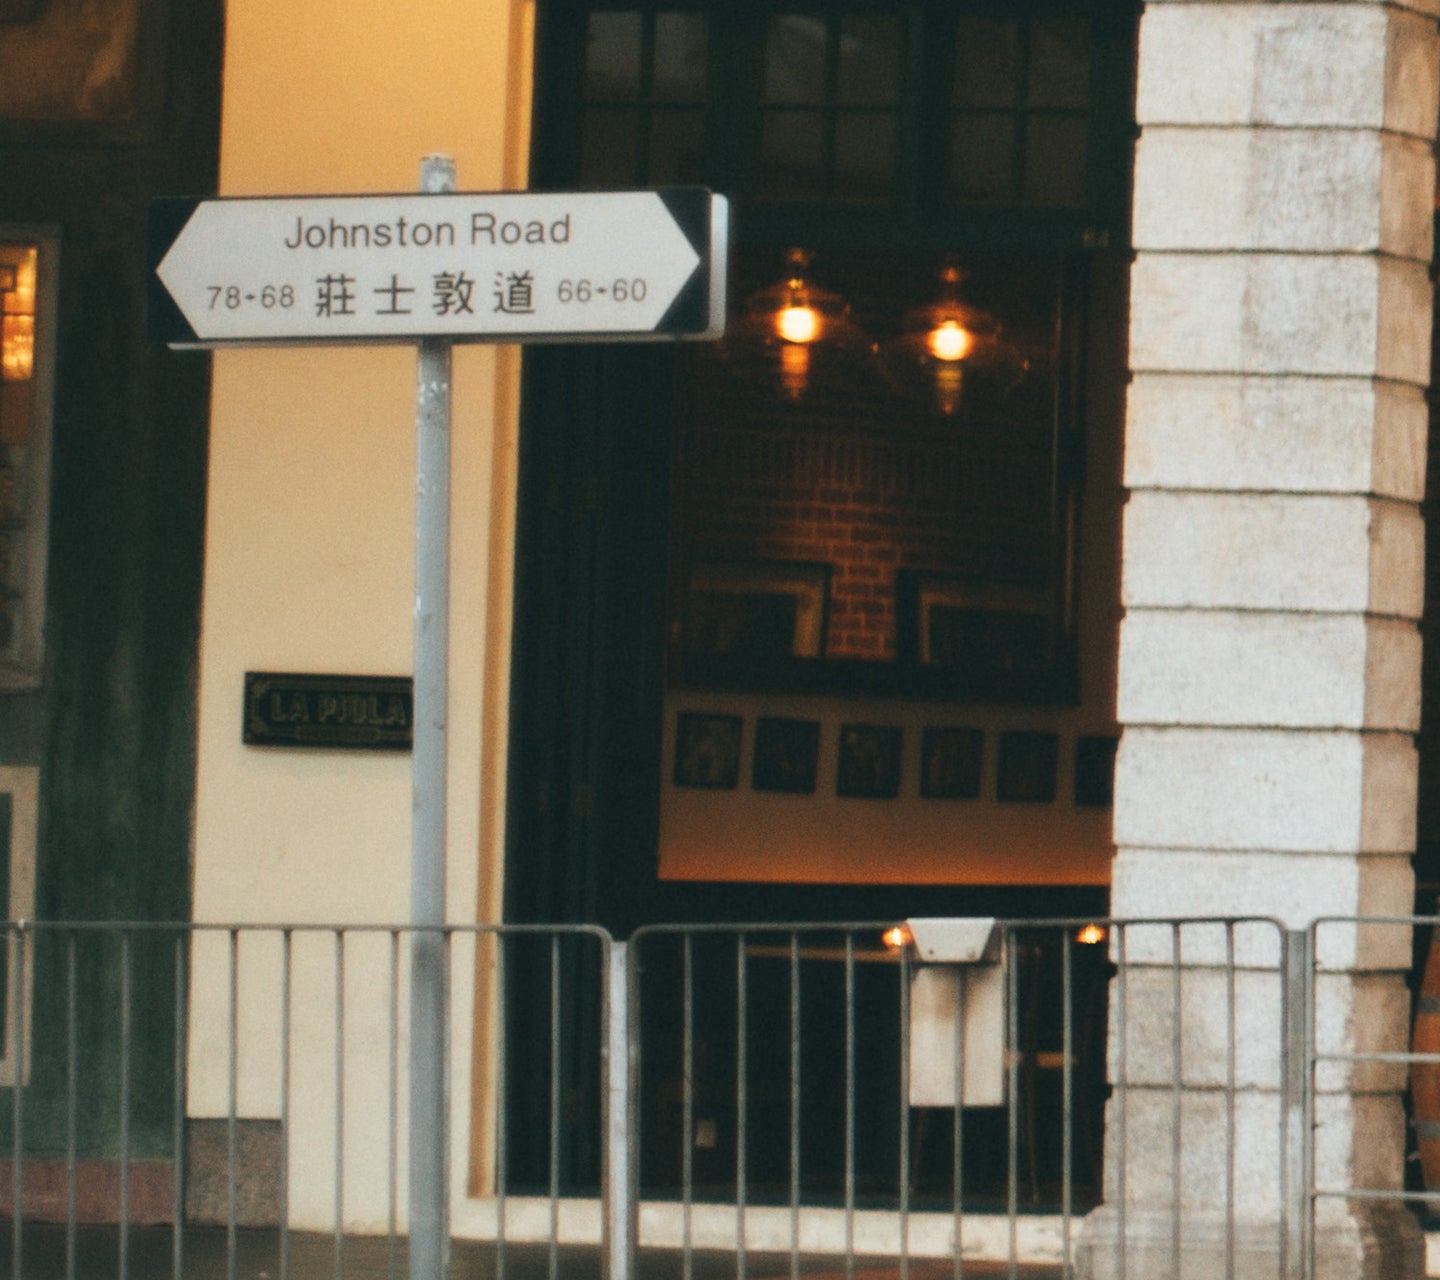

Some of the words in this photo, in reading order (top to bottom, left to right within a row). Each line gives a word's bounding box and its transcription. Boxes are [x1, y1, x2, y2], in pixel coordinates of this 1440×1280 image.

[285, 213, 455, 250] Johnston
[470, 213, 572, 245] Road
[315, 269, 537, 318] 莊士敦道
